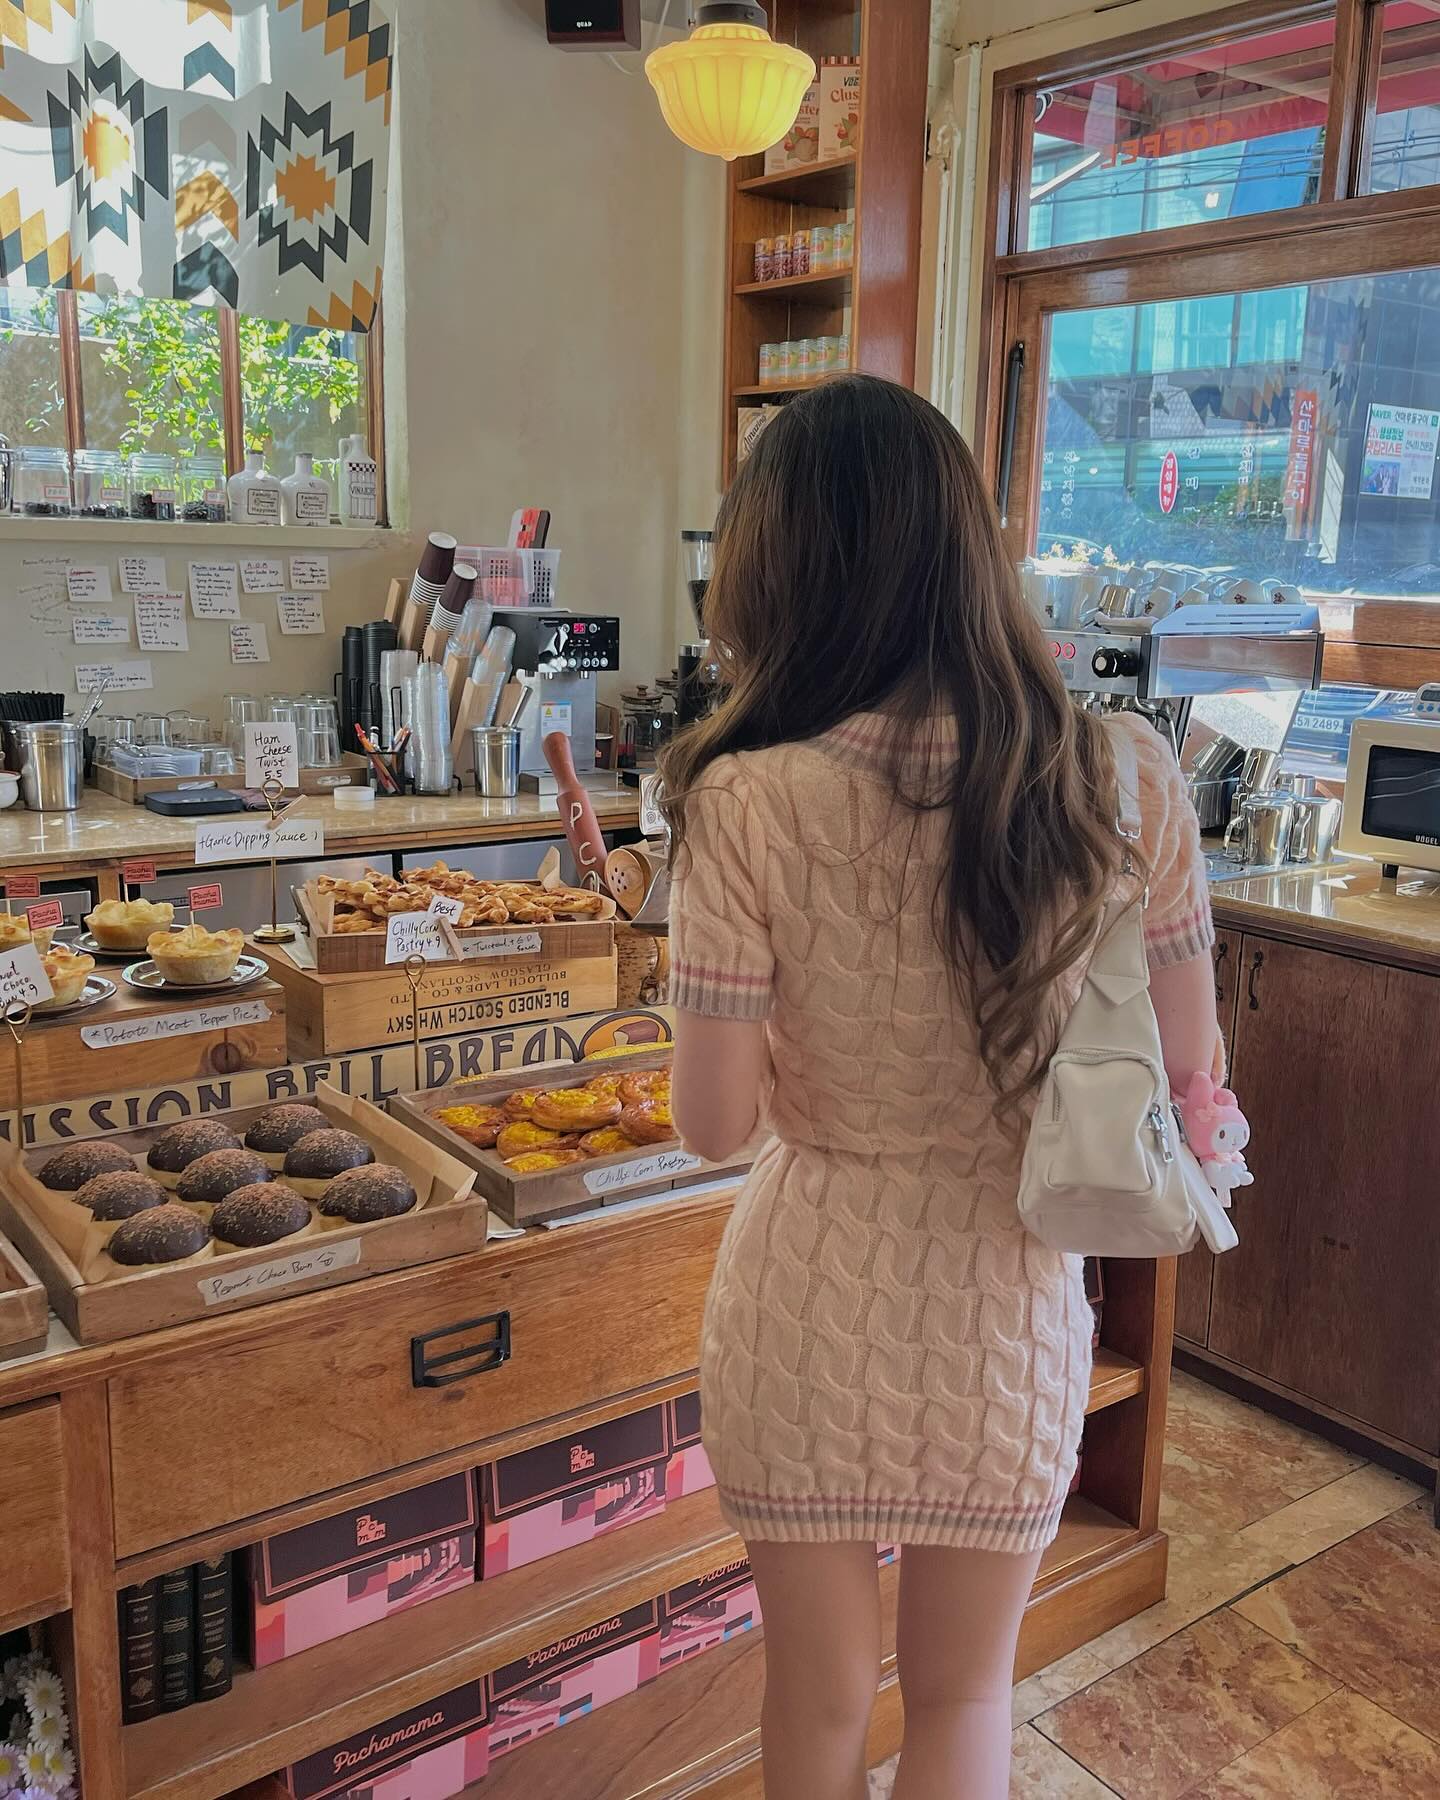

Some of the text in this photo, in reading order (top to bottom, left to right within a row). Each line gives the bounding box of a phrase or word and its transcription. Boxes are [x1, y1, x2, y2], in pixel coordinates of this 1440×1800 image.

[254, 732, 280, 746] Ham
[263, 745, 292, 756] Cheese
[256, 756, 285, 768] Twist
[264, 769, 283, 779] 5.5
[234, 831, 270, 850] Dipping
[275, 830, 308, 844] Sauce
[434, 902, 457, 916] Best
[3, 977, 29, 991] Choco
[466, 980, 500, 994] LADE
[387, 990, 569, 1034] BLENDED SCOTCH WHSKY
[104, 1026, 148, 1045] Potato
[155, 1018, 193, 1033] Meat
[199, 1012, 230, 1027] Pepper
[0, 1080, 232, 1143] ISSION
[527, 1616, 623, 1669] Pachamama
[333, 1711, 445, 1775] Pachamama
